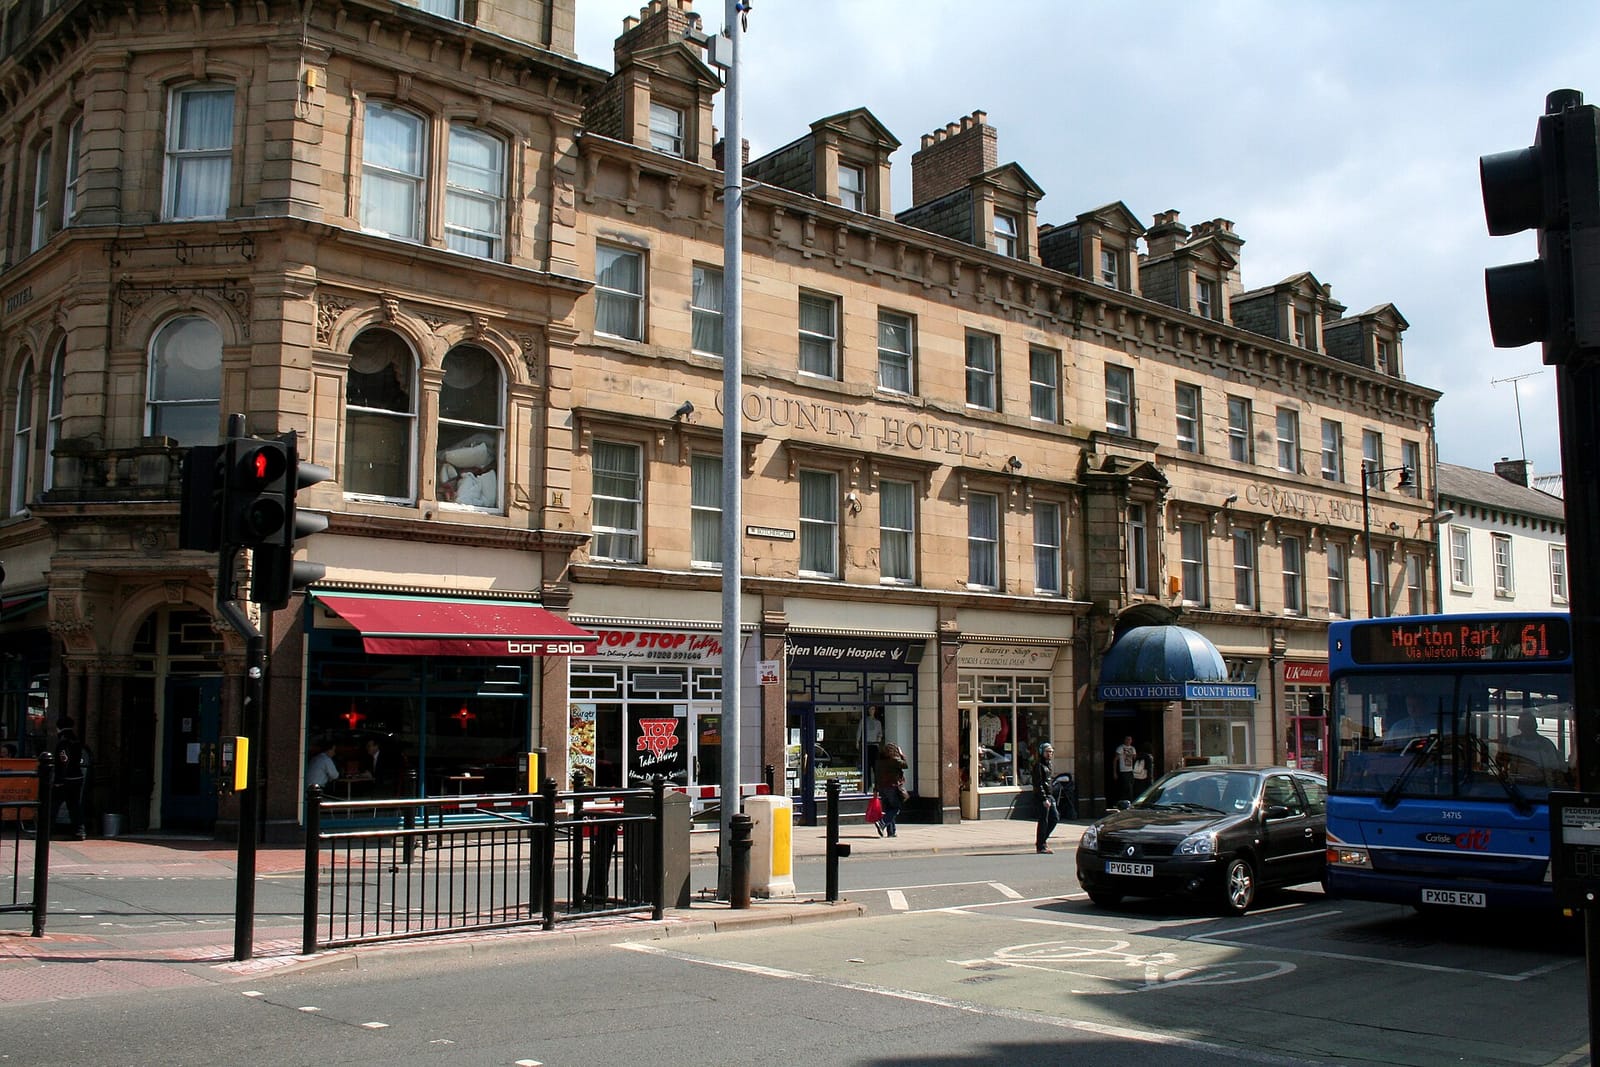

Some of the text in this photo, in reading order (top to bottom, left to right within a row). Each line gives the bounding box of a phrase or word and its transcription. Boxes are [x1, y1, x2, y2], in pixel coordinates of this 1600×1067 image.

[714, 390, 987, 459] OUNTY HOTEL
[1246, 484, 1322, 517] COUNTY
[637, 632, 686, 649] STOP
[1392, 625, 1500, 646] Morton Park
[1521, 624, 1549, 656] 61
[507, 640, 585, 654] bar solo
[784, 644, 886, 660] Eden Valley Hospice
[980, 646, 1009, 656] Charity
[1012, 647, 1031, 657] Shop
[1406, 646, 1486, 659] Via Wigton Road
[1286, 666, 1302, 679] UK
[1103, 686, 1181, 697] COUNTY HOTEL
[1192, 686, 1251, 697] COUNTY HOTEL
[573, 708, 595, 719] Burger
[643, 722, 675, 737] TOP
[636, 735, 679, 751] STOP
[639, 751, 678, 767] Take Away
[1442, 811, 1462, 820] 34715
[1425, 833, 1451, 843] Carlisle
[1110, 863, 1152, 875] PY05 EAP
[1426, 891, 1483, 905] PX05 EKJ
